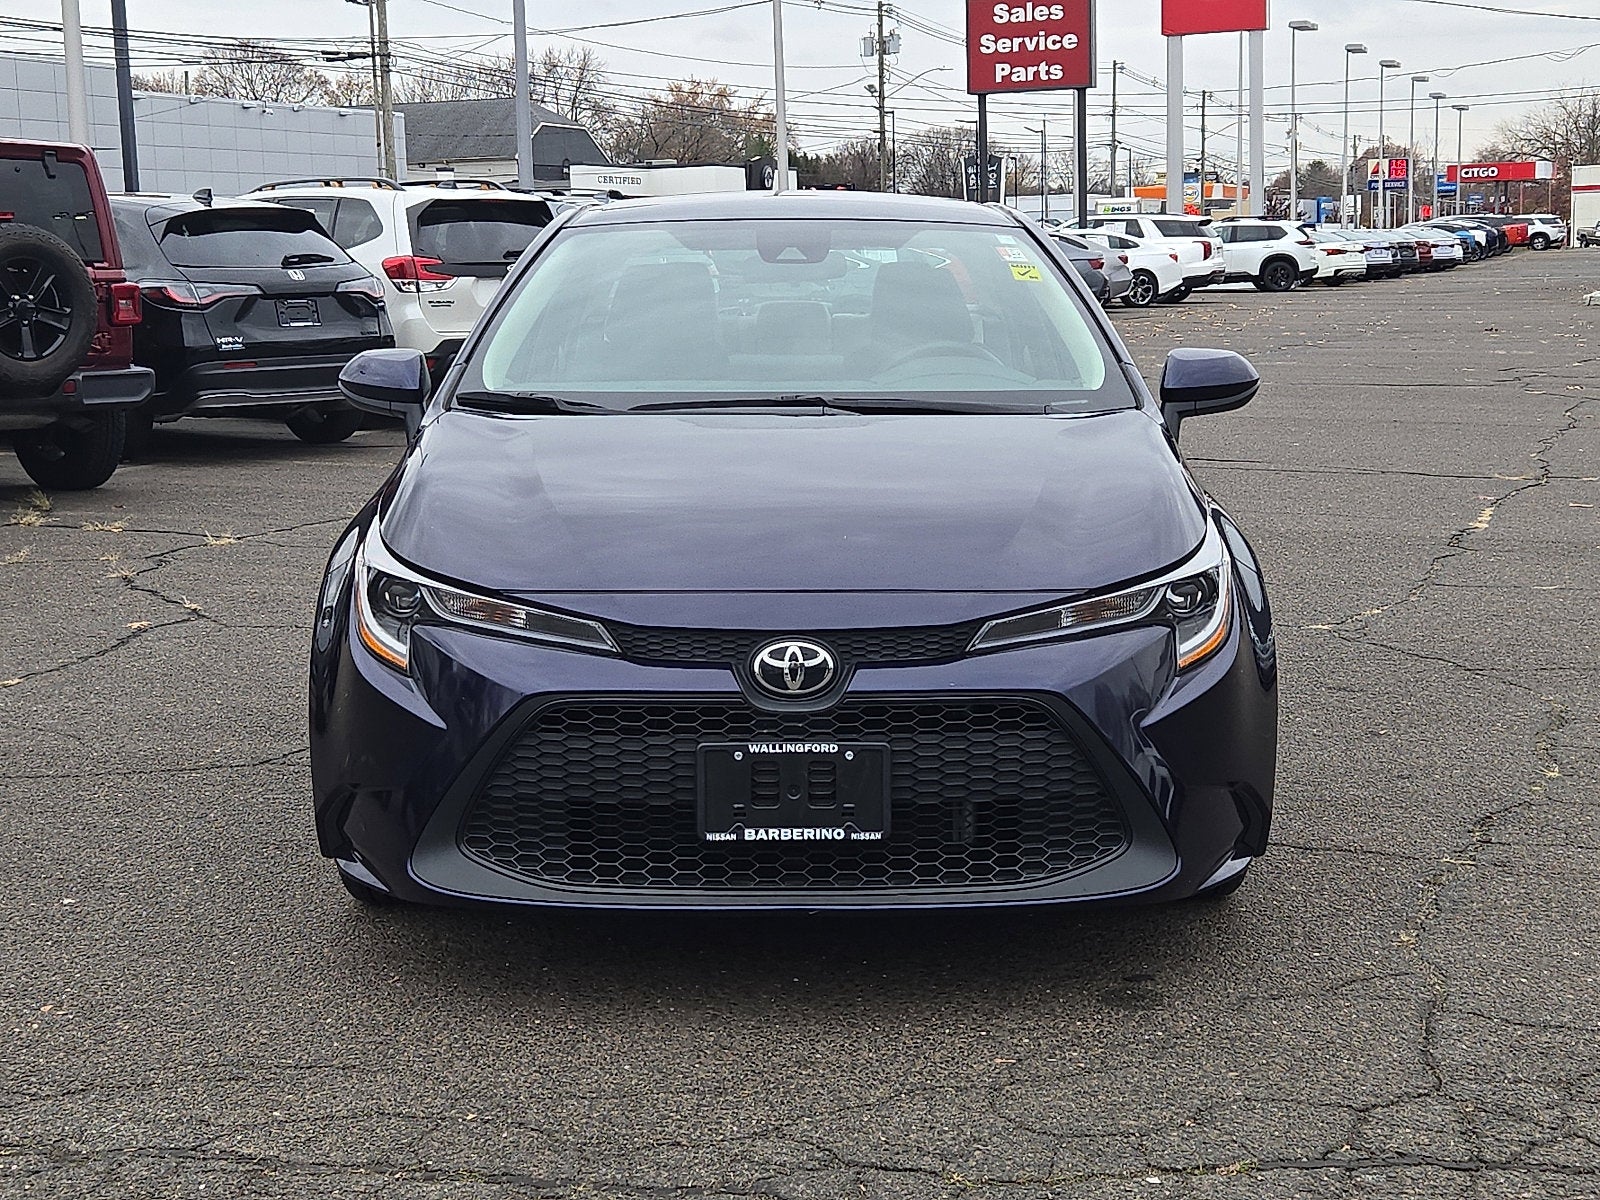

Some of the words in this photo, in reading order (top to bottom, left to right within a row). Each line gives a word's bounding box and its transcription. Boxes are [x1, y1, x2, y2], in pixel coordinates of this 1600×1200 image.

[993, 2, 1064, 24] Sales
[980, 31, 1078, 54] Service
[995, 61, 1063, 83] Parts
[1461, 167, 1498, 178] CITGO
[597, 175, 641, 185] CERTIFIED
[748, 743, 839, 753] WALLINGFORD
[706, 832, 737, 841] NISSAN
[744, 828, 845, 841] BARBERINO
[850, 832, 882, 840] NISSAN
